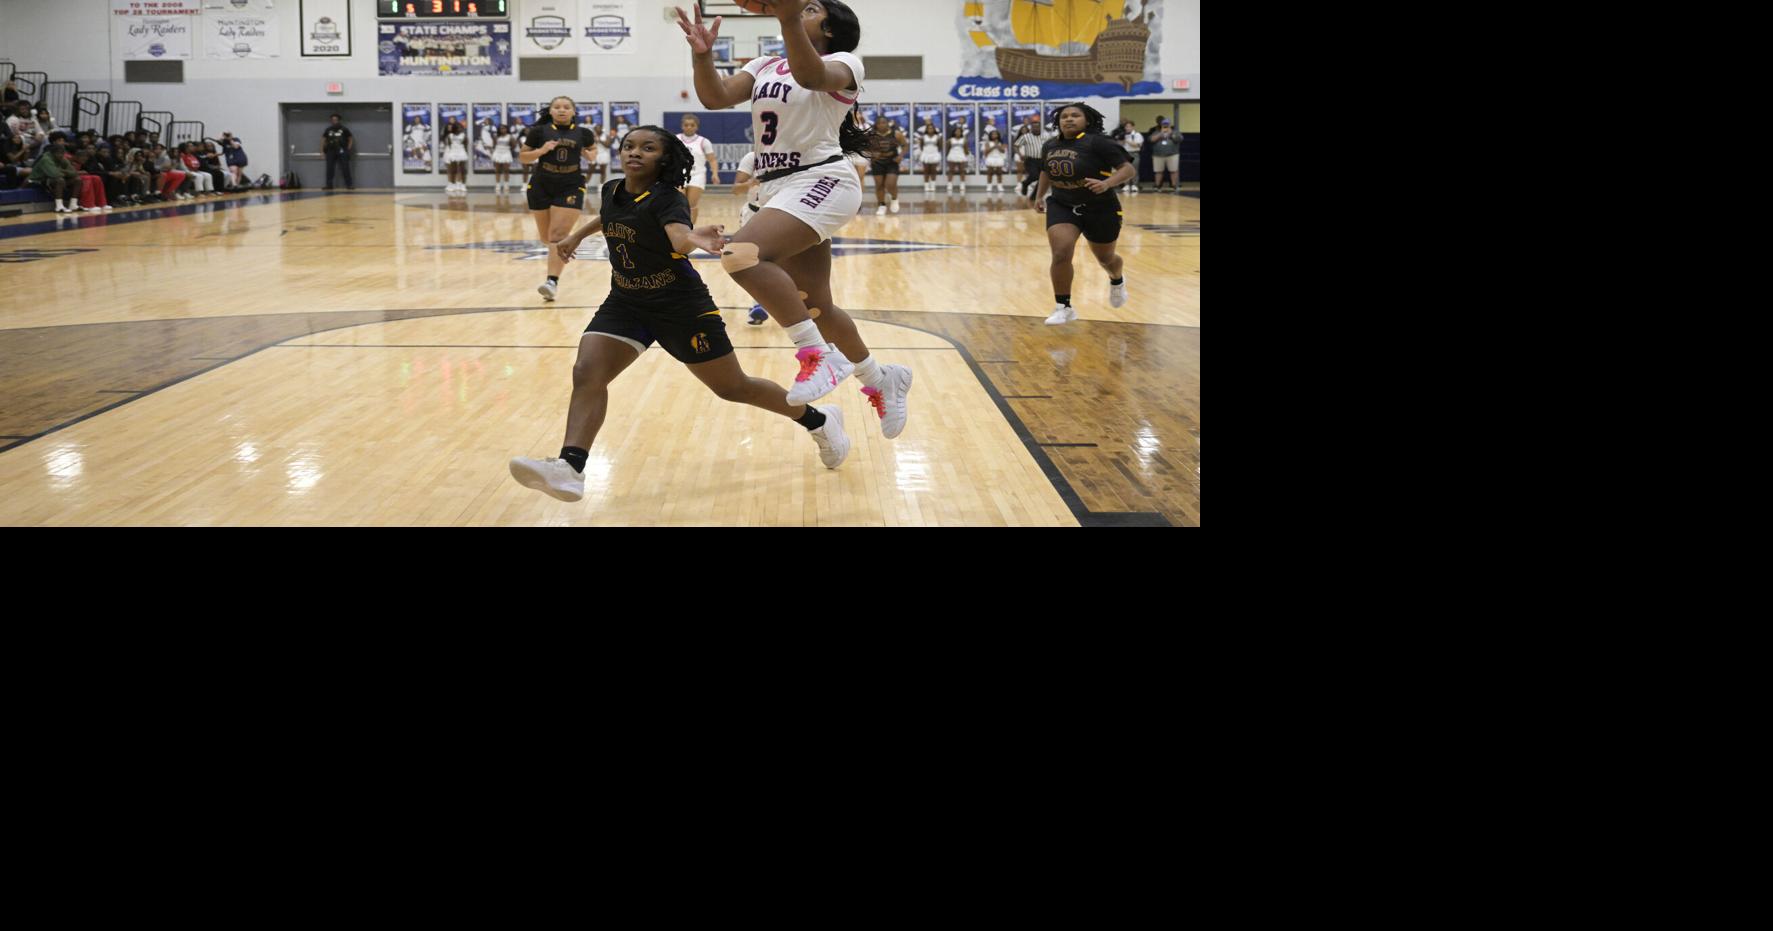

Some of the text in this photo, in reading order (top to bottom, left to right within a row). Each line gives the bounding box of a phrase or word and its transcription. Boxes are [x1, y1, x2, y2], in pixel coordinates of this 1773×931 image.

[146, 8, 200, 16] TOURNAMENT
[128, 24, 186, 38] Lady Raiders
[400, 25, 438, 35] STATE
[439, 25, 488, 35] CHAMPS
[399, 55, 490, 66] HUNTINGTON
[957, 84, 1040, 98] Class of 88
[760, 110, 779, 146] 3
[1048, 159, 1074, 177] 30
[616, 243, 635, 269] 1
